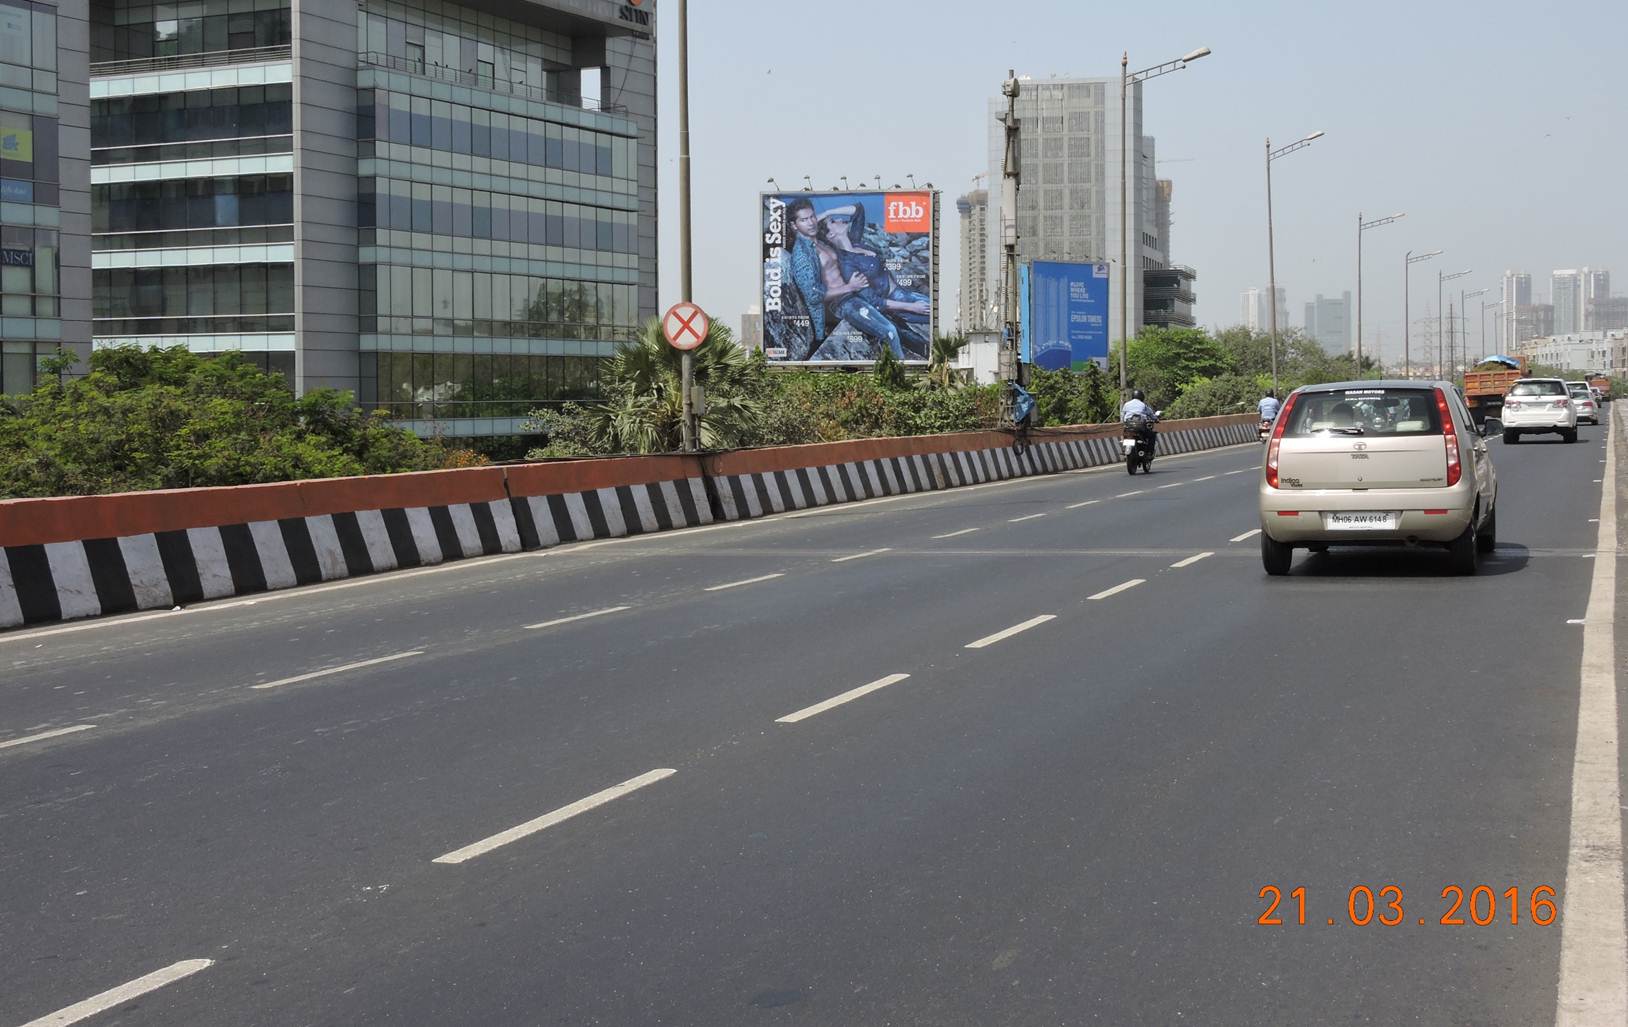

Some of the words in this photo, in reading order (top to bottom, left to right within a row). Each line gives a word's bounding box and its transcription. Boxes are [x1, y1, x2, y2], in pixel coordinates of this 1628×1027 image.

[888, 201, 924, 219] fbb
[766, 197, 786, 244] Sexy
[2, 250, 33, 266] MSCI
[766, 247, 782, 263] is
[766, 264, 782, 313] Bold
[1353, 515, 1368, 523] AW
